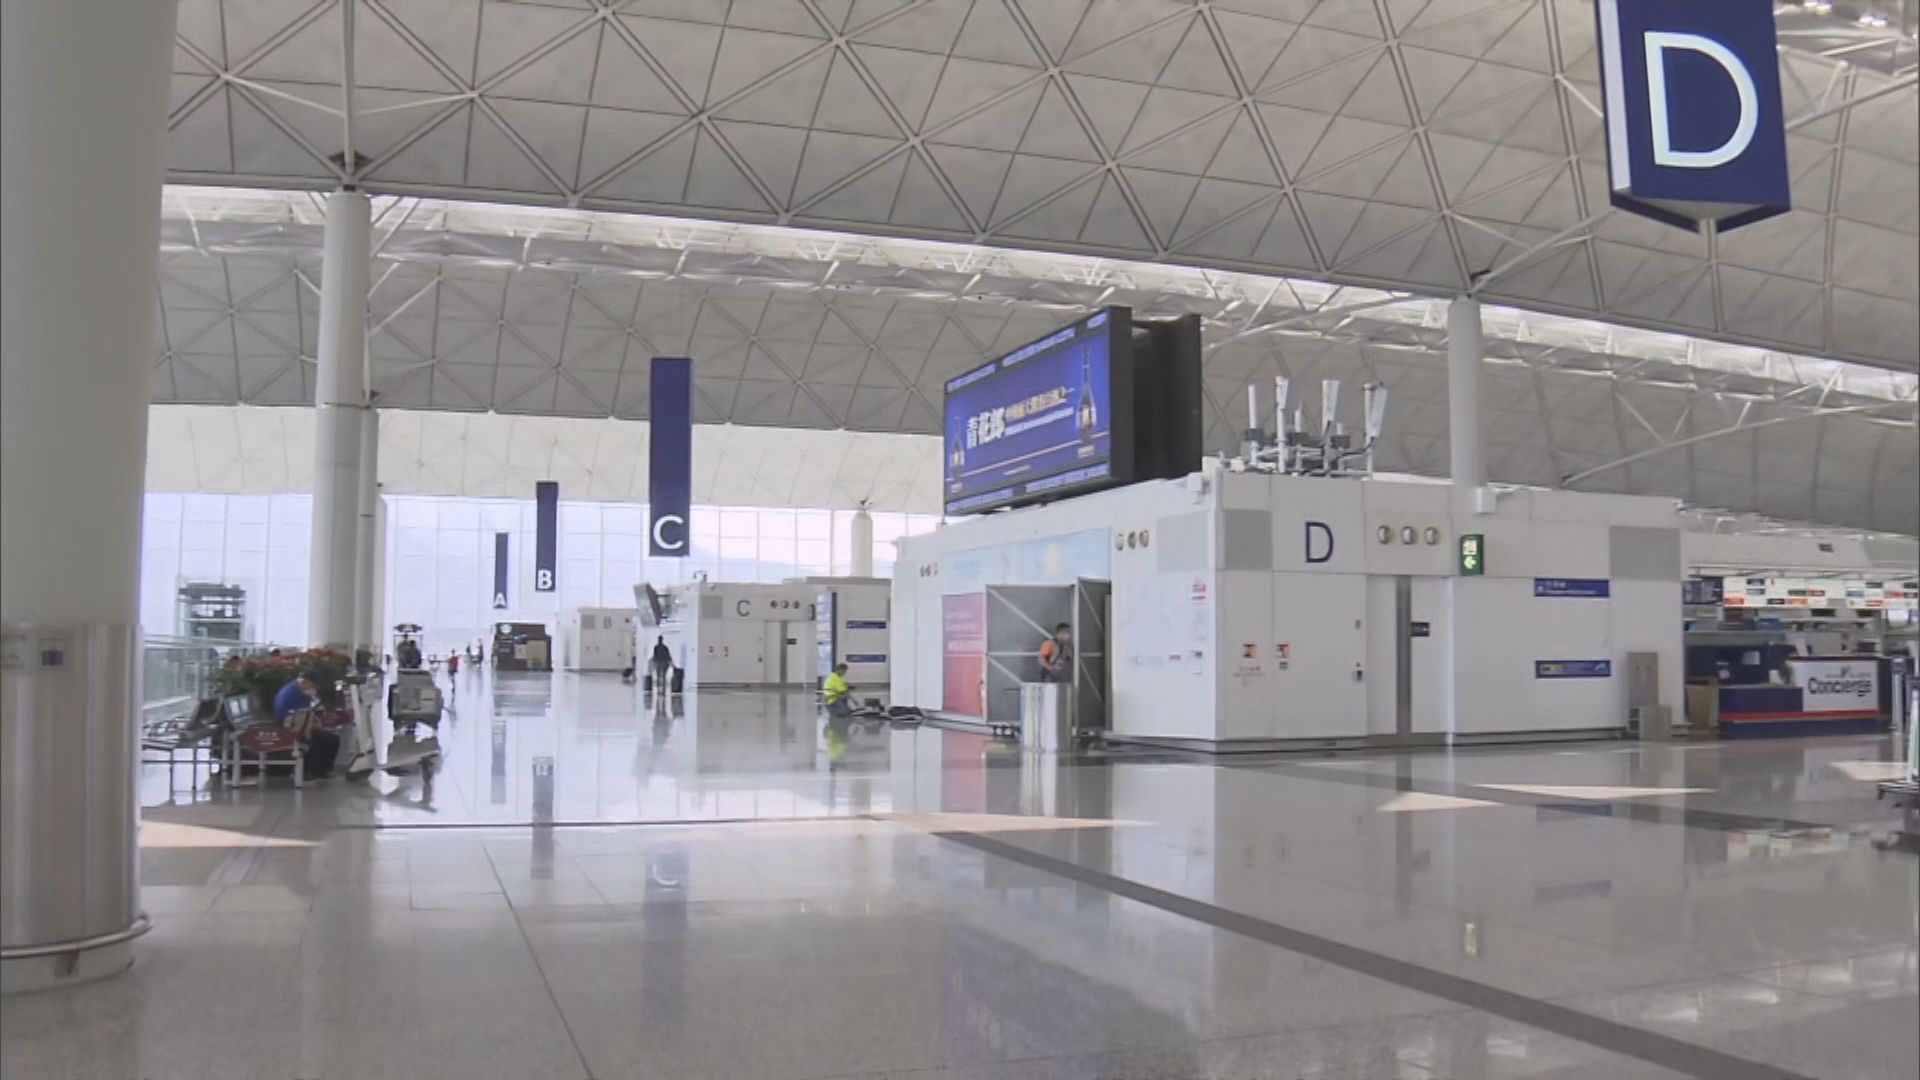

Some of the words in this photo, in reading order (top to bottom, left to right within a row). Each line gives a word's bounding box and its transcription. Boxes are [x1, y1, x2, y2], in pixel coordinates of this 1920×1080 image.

[1644, 31, 1759, 168] D
[653, 515, 685, 550] C
[1305, 521, 1335, 563] D
[537, 569, 553, 590] B
[494, 593, 508, 608] A
[736, 599, 751, 617] C
[1808, 677, 1872, 697] Concierge
